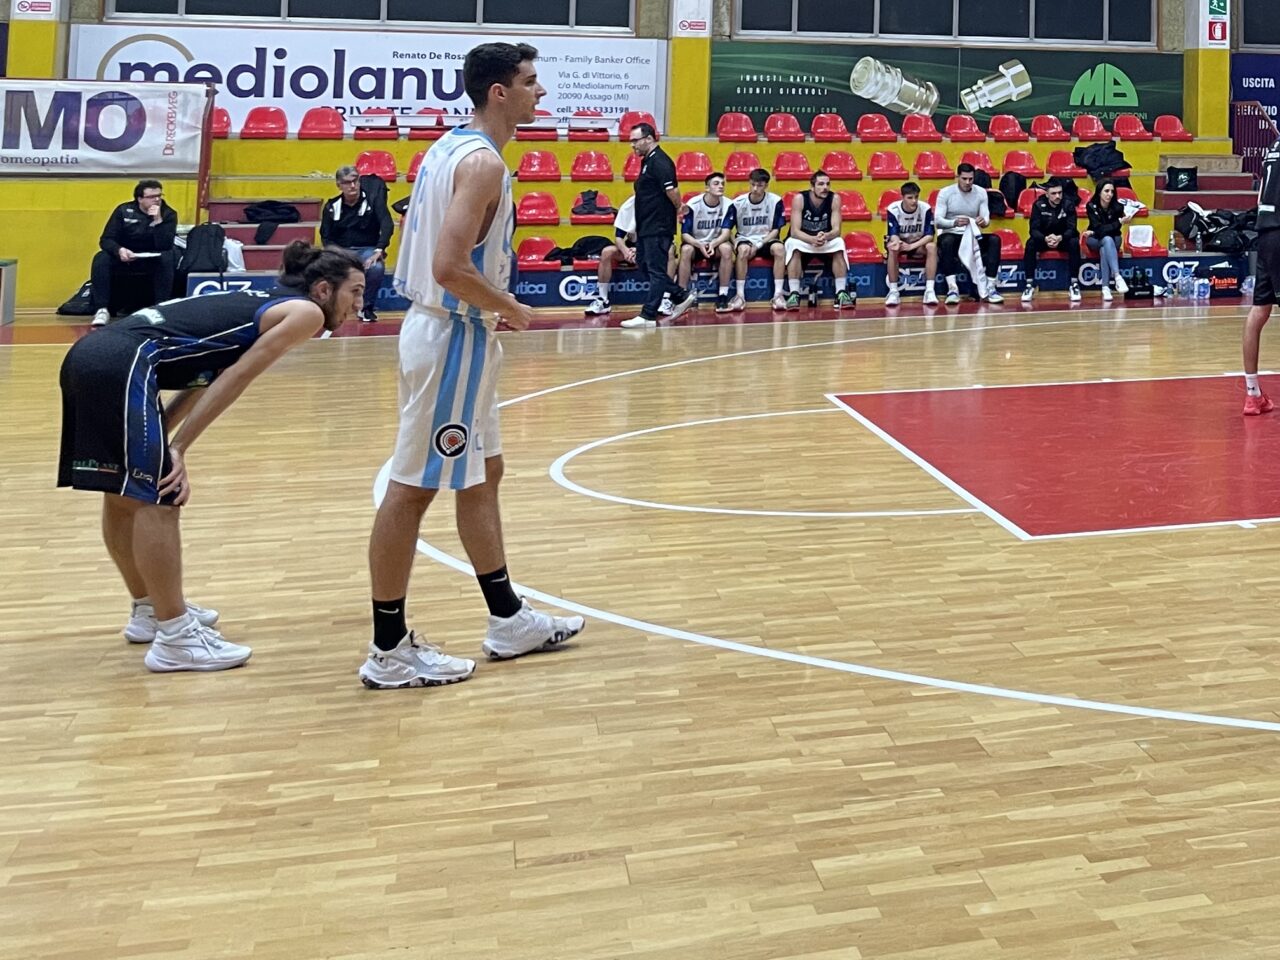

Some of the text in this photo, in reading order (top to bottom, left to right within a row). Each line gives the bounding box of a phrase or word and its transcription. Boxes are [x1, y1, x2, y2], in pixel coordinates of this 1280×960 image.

[392, 51, 427, 60] Renato
[429, 51, 442, 60] De
[565, 55, 593, 65] Family
[595, 55, 624, 64] Banker
[625, 56, 651, 65] Office
[119, 48, 468, 101] mediolanu
[740, 74, 826, 83] INNESTI RAPIDI
[558, 82, 650, 91] c/o Mediolanum Forum
[1242, 77, 1276, 89] USCITA
[736, 86, 772, 95] GIUNTI
[558, 92, 582, 100] 20090
[584, 93, 612, 102] Assago
